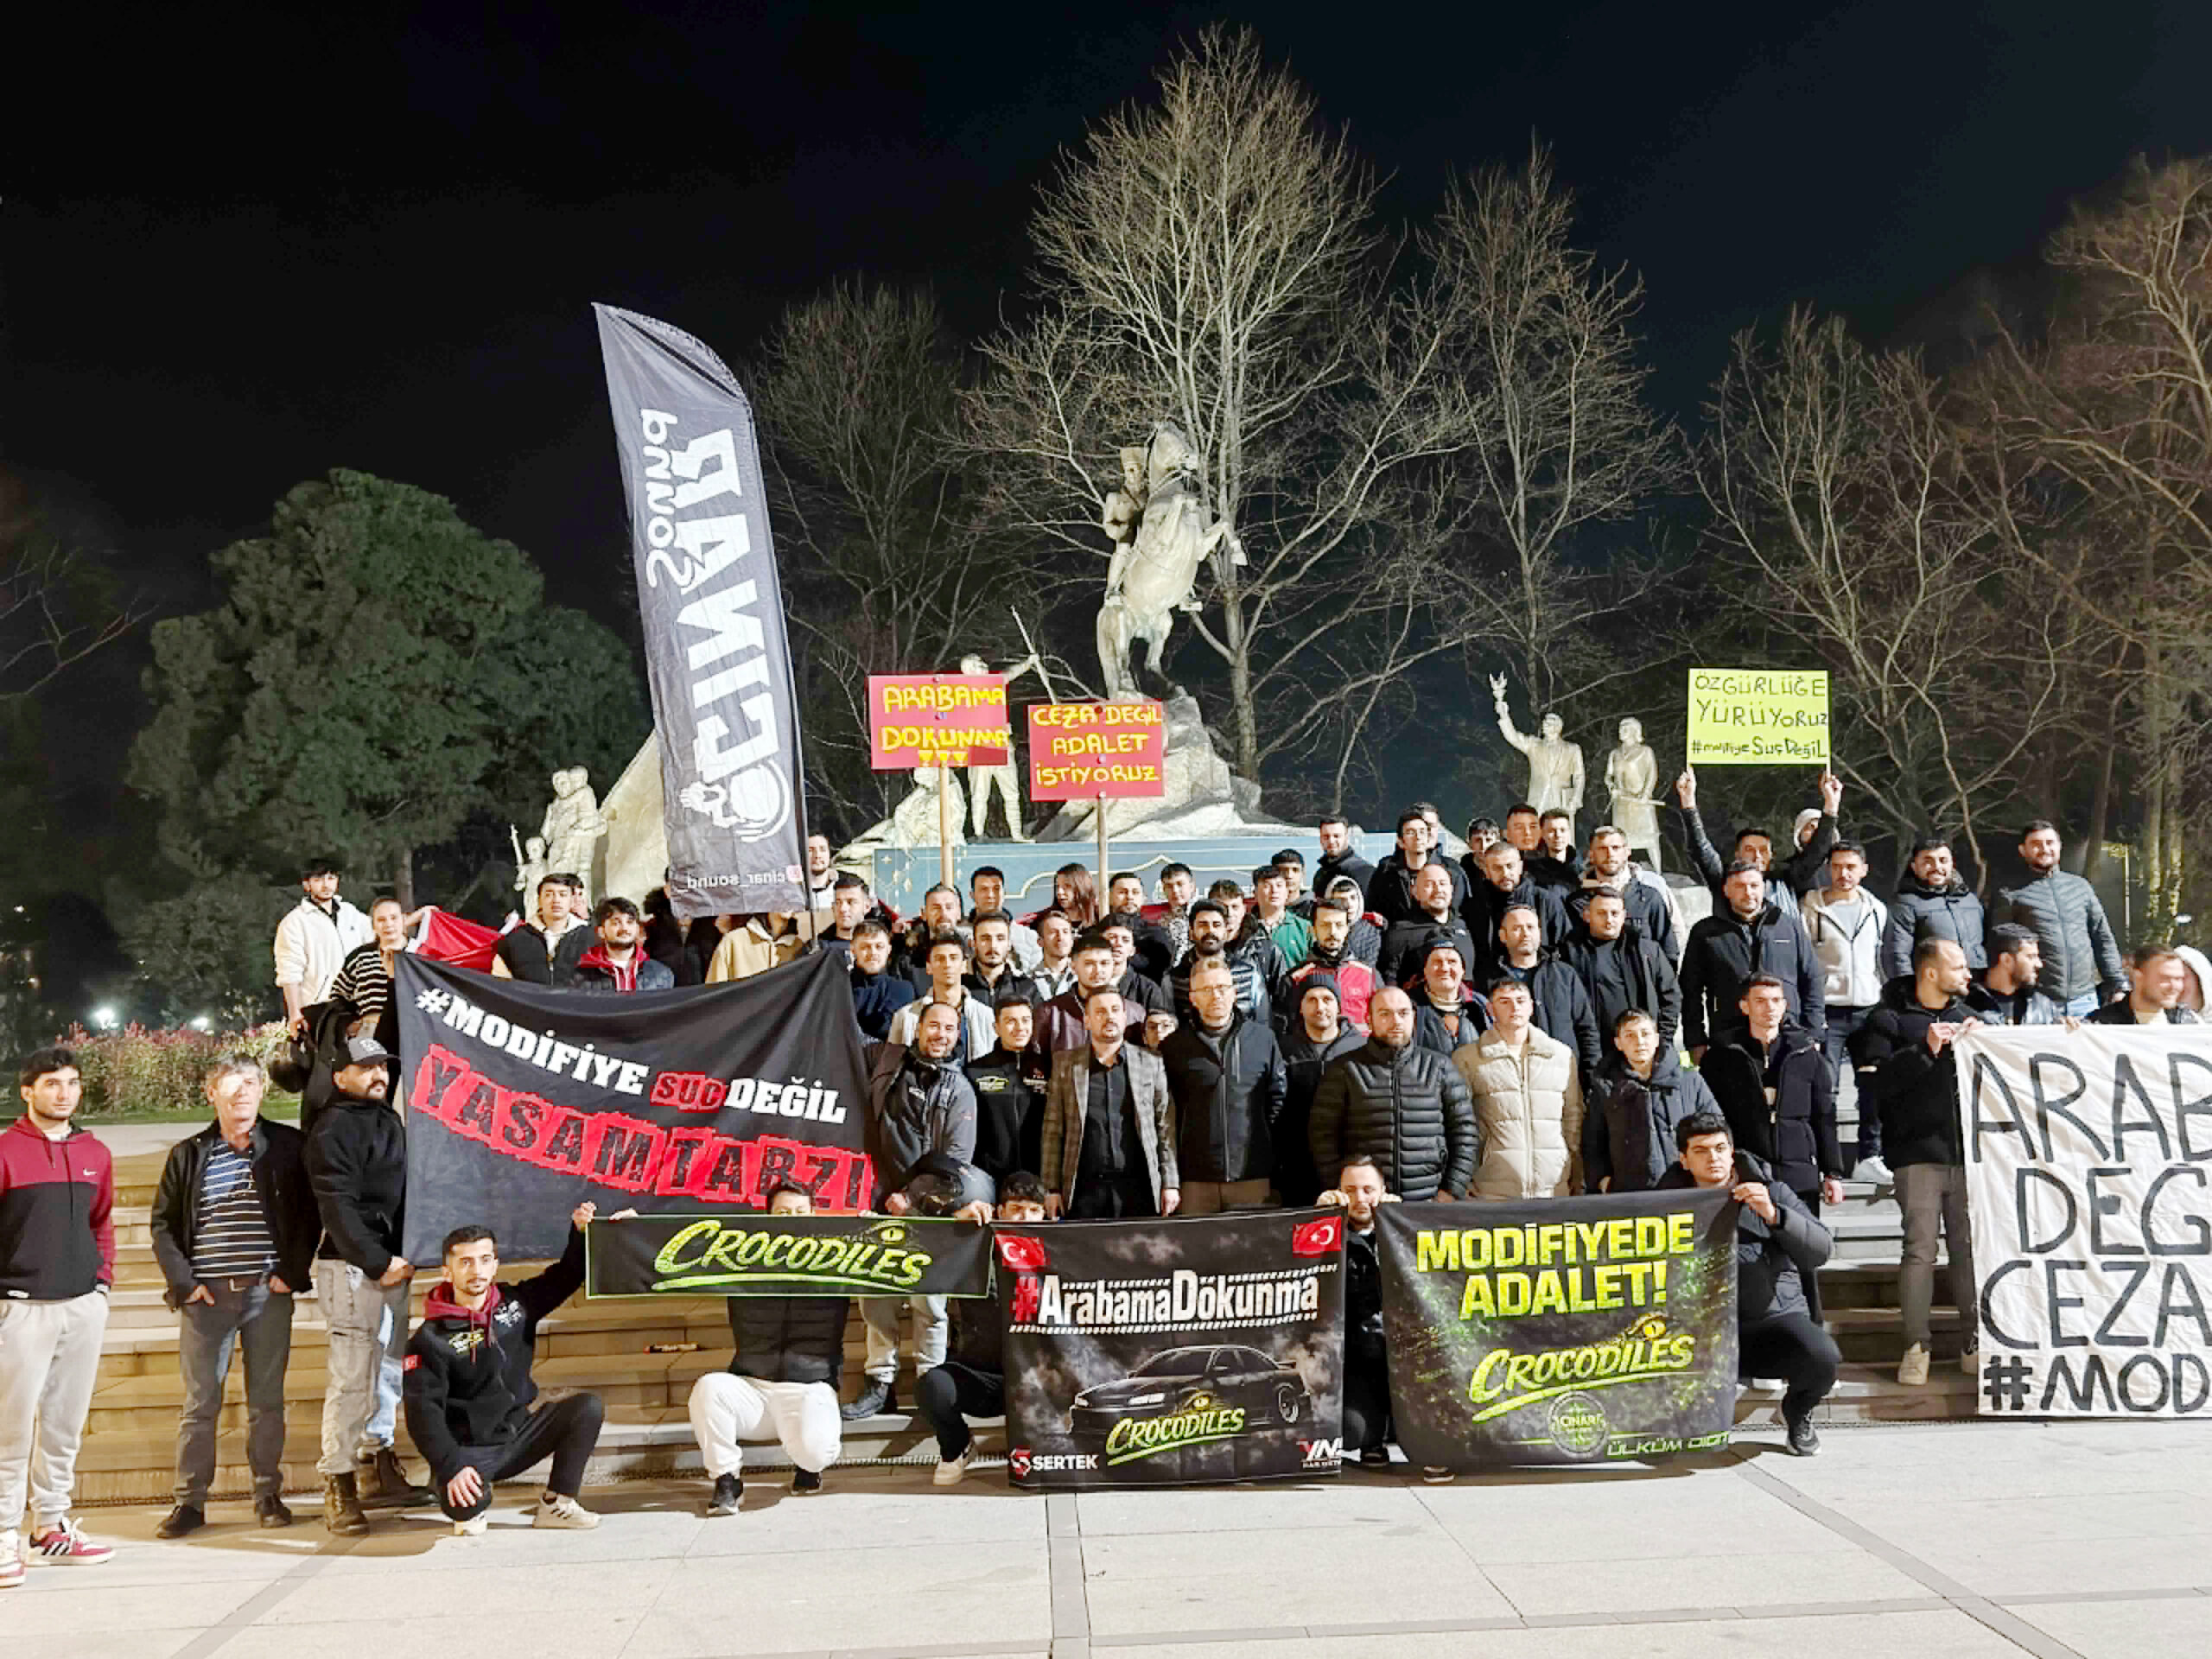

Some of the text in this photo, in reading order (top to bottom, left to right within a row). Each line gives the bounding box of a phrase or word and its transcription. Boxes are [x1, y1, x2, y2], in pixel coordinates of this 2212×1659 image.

[882, 685, 1007, 714] ARABAMA
[1033, 705, 1097, 728] CEZA
[881, 727, 1009, 751] DOKUNMA
[1053, 734, 1150, 757] ADALET
[1035, 761, 1160, 785] İSTİYORUZ
[415, 987, 650, 1095] #MODİFİYE
[723, 1075, 848, 1123] DEĞİL
[1971, 1052, 2212, 1163] ARAB
[653, 1219, 933, 1286] CROCODILES
[1415, 1212, 1695, 1273] MODİFİYEDE
[1012, 1269, 1319, 1325] #ArabamaDokunma
[1459, 1260, 1668, 1321] ADALET!
[1980, 1260, 2212, 1350] CEZA
[1469, 1334, 1696, 1404] CROCODILES
[1983, 1352, 2210, 1414] #MOD
[1105, 1407, 1246, 1455] CROCODILES
[1033, 1454, 1098, 1471] SERTEK
